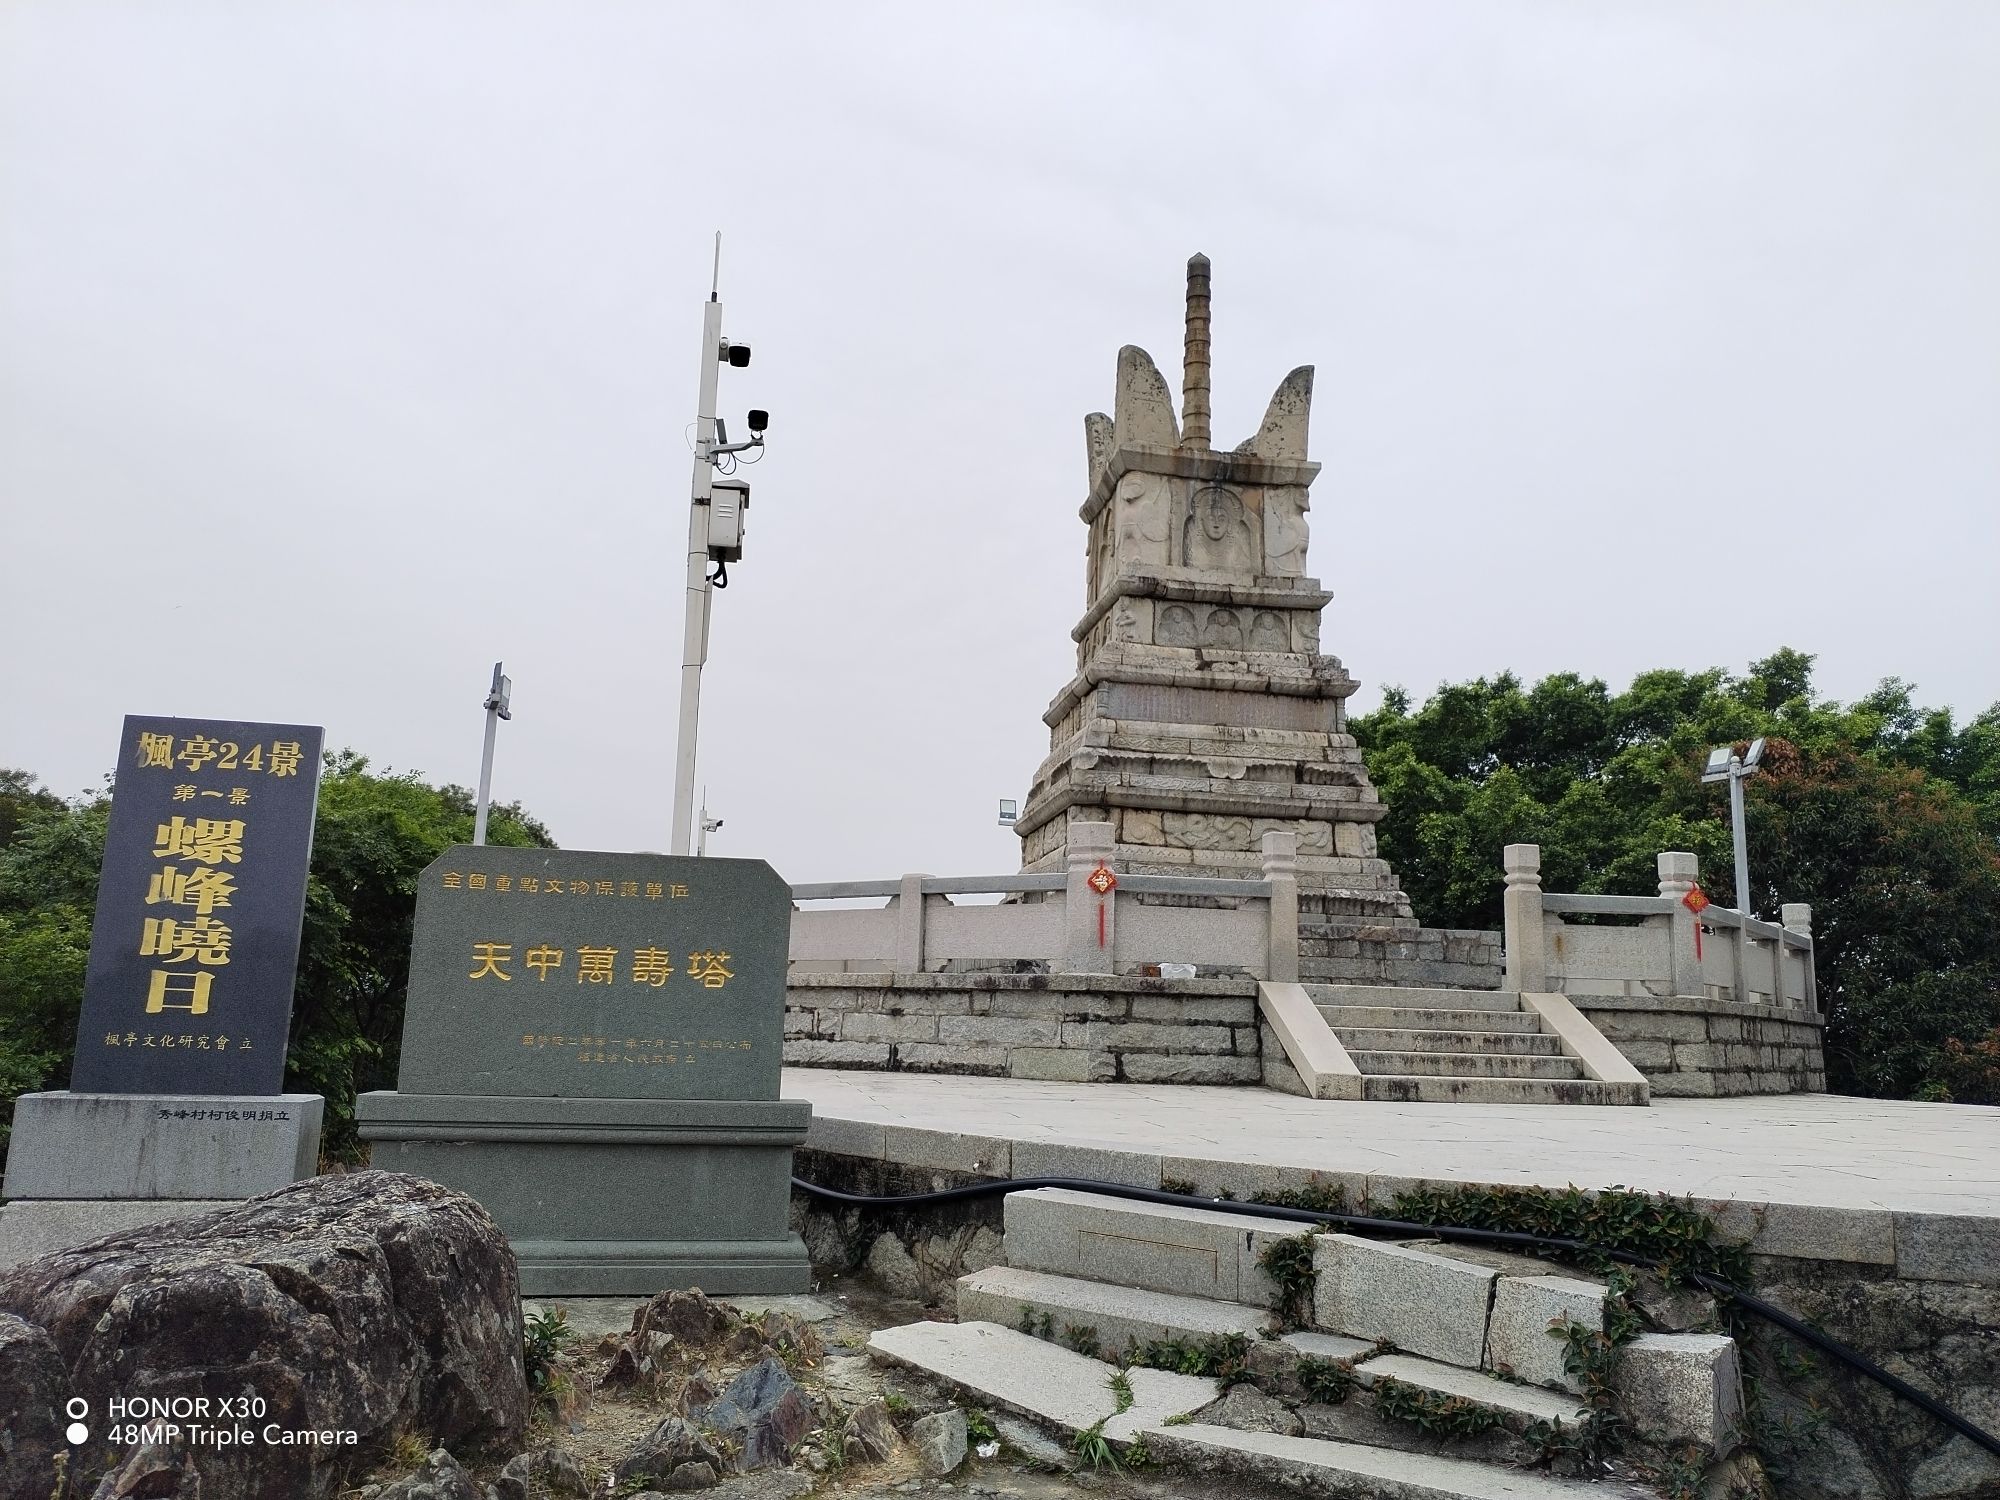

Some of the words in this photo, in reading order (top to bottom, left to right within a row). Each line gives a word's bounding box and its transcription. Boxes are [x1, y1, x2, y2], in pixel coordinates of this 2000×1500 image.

[136, 731, 304, 777] 楓亭24景
[173, 784, 250, 805] 第一景
[442, 871, 690, 900] 全國重點文物保護單位
[140, 816, 246, 1014] 螺峰曉日
[469, 942, 735, 988] 天中萬壽塔
